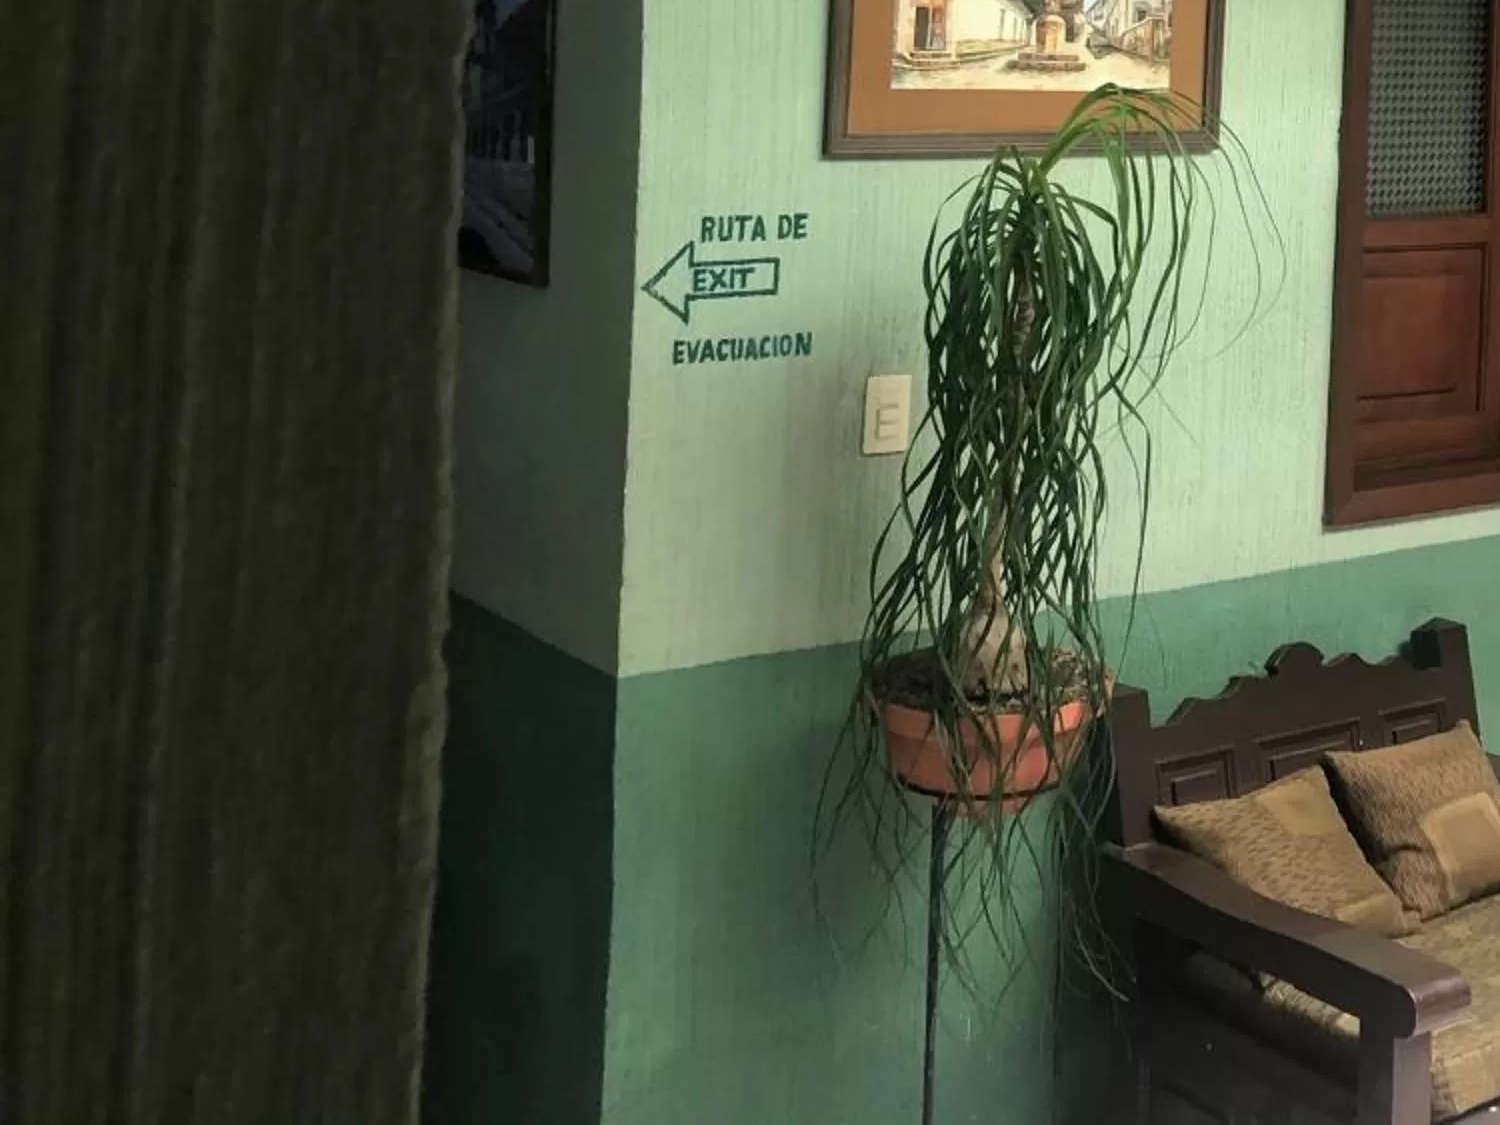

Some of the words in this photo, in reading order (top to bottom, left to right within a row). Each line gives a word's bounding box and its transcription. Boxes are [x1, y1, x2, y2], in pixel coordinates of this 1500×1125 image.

[701, 214, 767, 243] RUTA
[777, 212, 809, 239] DE
[692, 267, 756, 293] EXIT
[672, 331, 813, 365] EVACUACION
